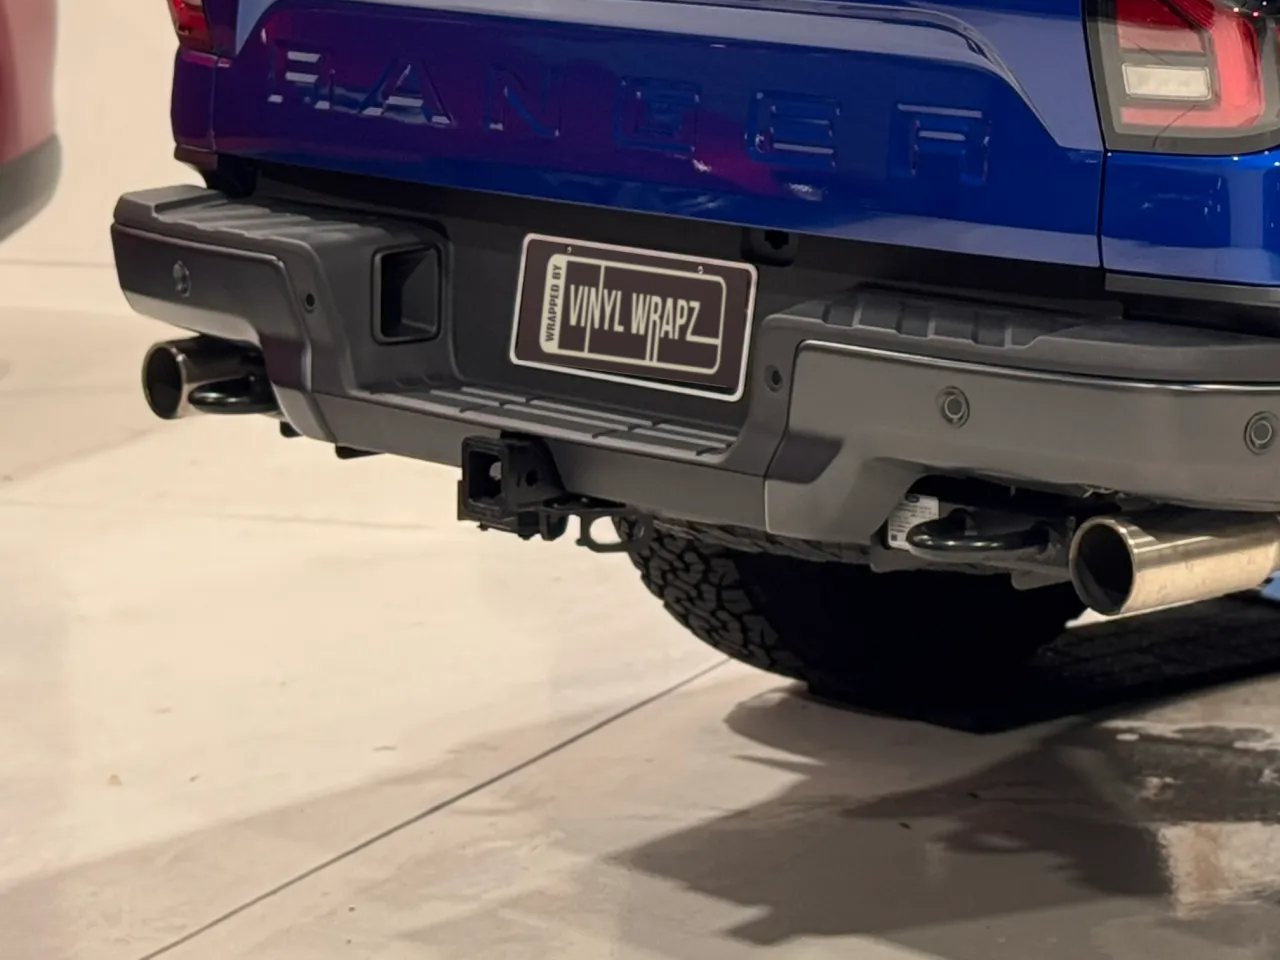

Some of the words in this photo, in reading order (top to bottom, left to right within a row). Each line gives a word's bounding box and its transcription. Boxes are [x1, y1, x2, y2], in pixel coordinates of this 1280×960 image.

[267, 43, 991, 187] RANGER
[544, 284, 560, 342] WRAPPED
[552, 263, 563, 281] BY
[569, 283, 625, 334] VINYL
[631, 291, 702, 343] WRAPZ
